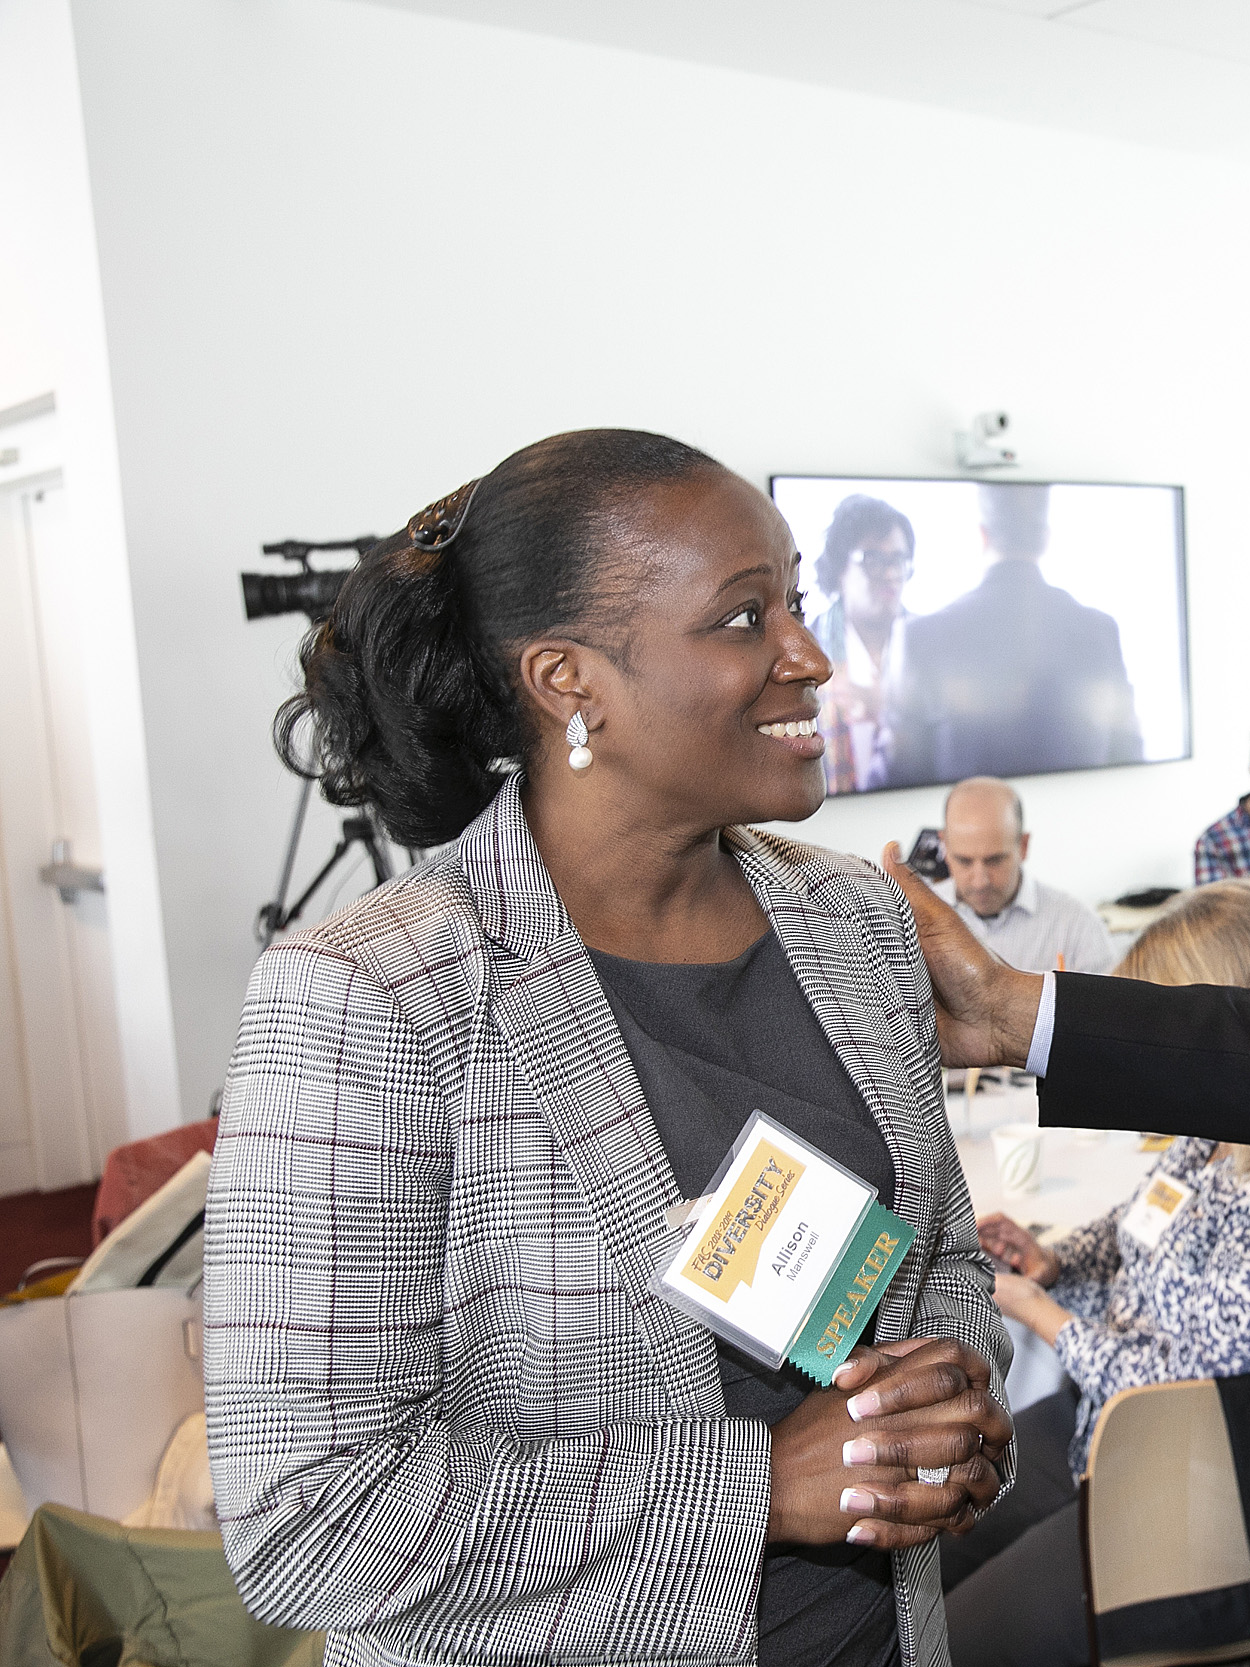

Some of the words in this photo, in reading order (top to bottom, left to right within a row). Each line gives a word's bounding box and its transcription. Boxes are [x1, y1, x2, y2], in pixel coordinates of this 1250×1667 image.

[702, 1156, 783, 1282] DIVERSITY
[754, 1195, 780, 1232] Dialogue
[775, 1169, 796, 1198] Series
[691, 1245, 712, 1271] FAS
[708, 1210, 735, 1250] 2018-2019
[771, 1220, 809, 1276] Allison
[786, 1231, 820, 1282] Manswell
[816, 1231, 900, 1359] SPEAKER
